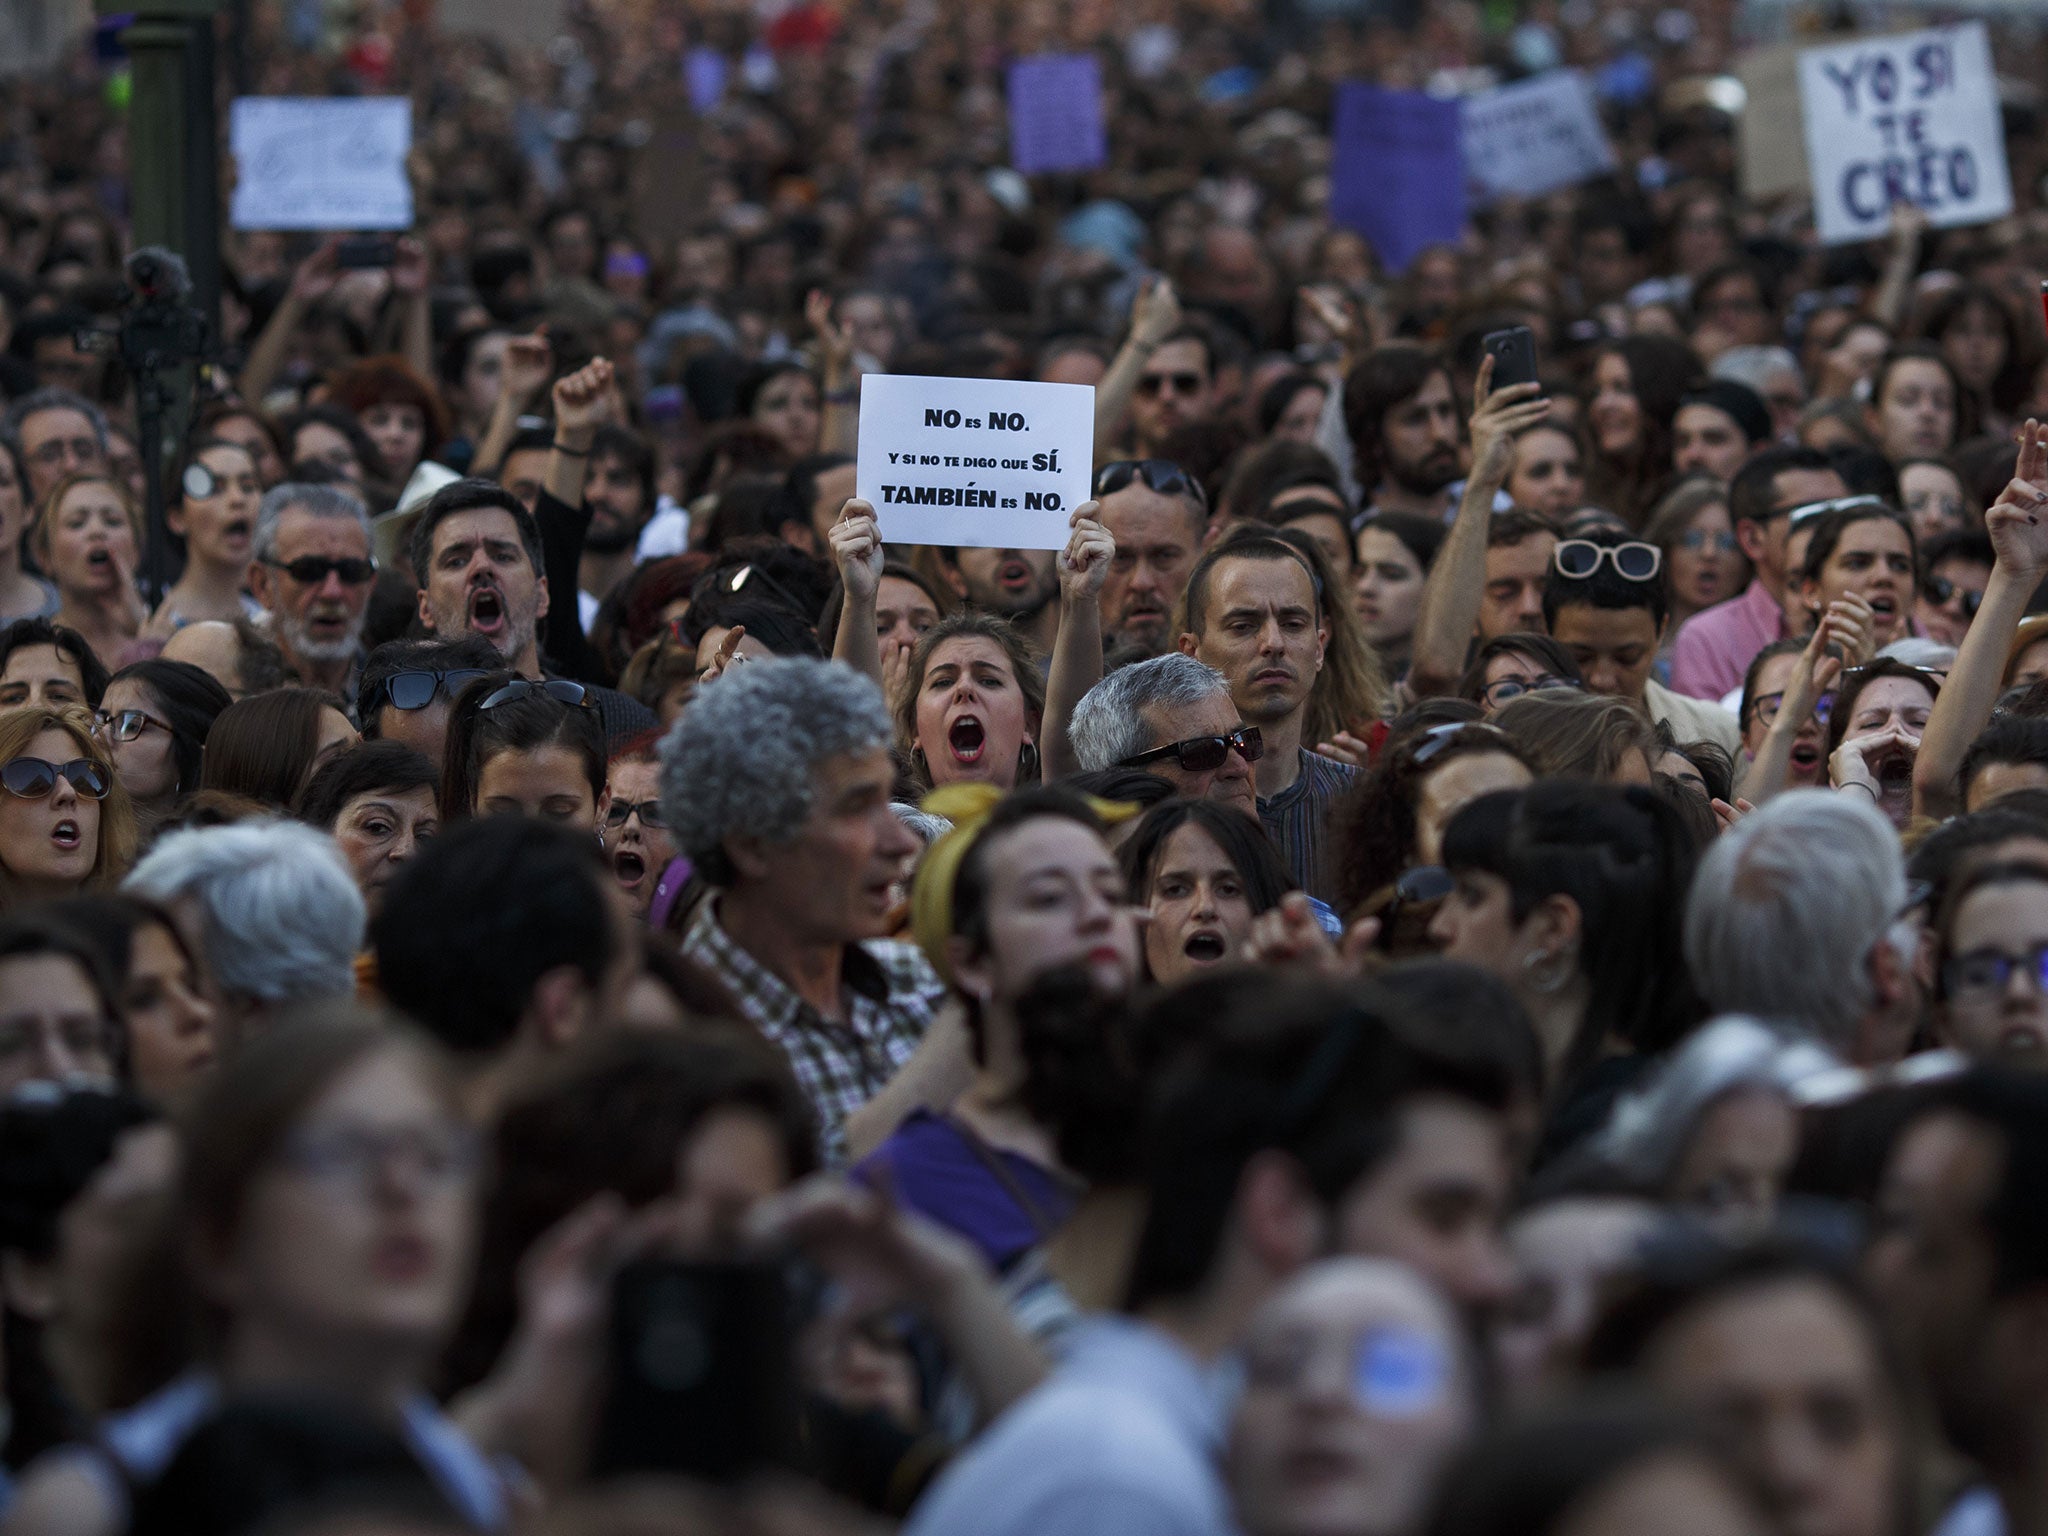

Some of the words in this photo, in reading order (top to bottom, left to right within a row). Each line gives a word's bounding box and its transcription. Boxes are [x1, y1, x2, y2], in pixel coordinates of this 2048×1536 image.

[1824, 55, 1897, 115] YO
[1872, 109, 1923, 146] TE
[1841, 143, 1977, 222] CREO
[924, 408, 962, 429] NO
[965, 418, 982, 429] ES
[988, 411, 1030, 432] NO.
[888, 452, 899, 465] Y
[902, 453, 917, 465] SI
[919, 455, 941, 466] NO
[943, 456, 960, 467] TE
[963, 457, 998, 469] DIGO
[1000, 458, 1029, 470] QUE
[1031, 448, 1063, 474] SÍ,
[880, 481, 997, 509] TAMBIÉN
[1000, 497, 1018, 509] ES
[1024, 491, 1067, 512] NO.
